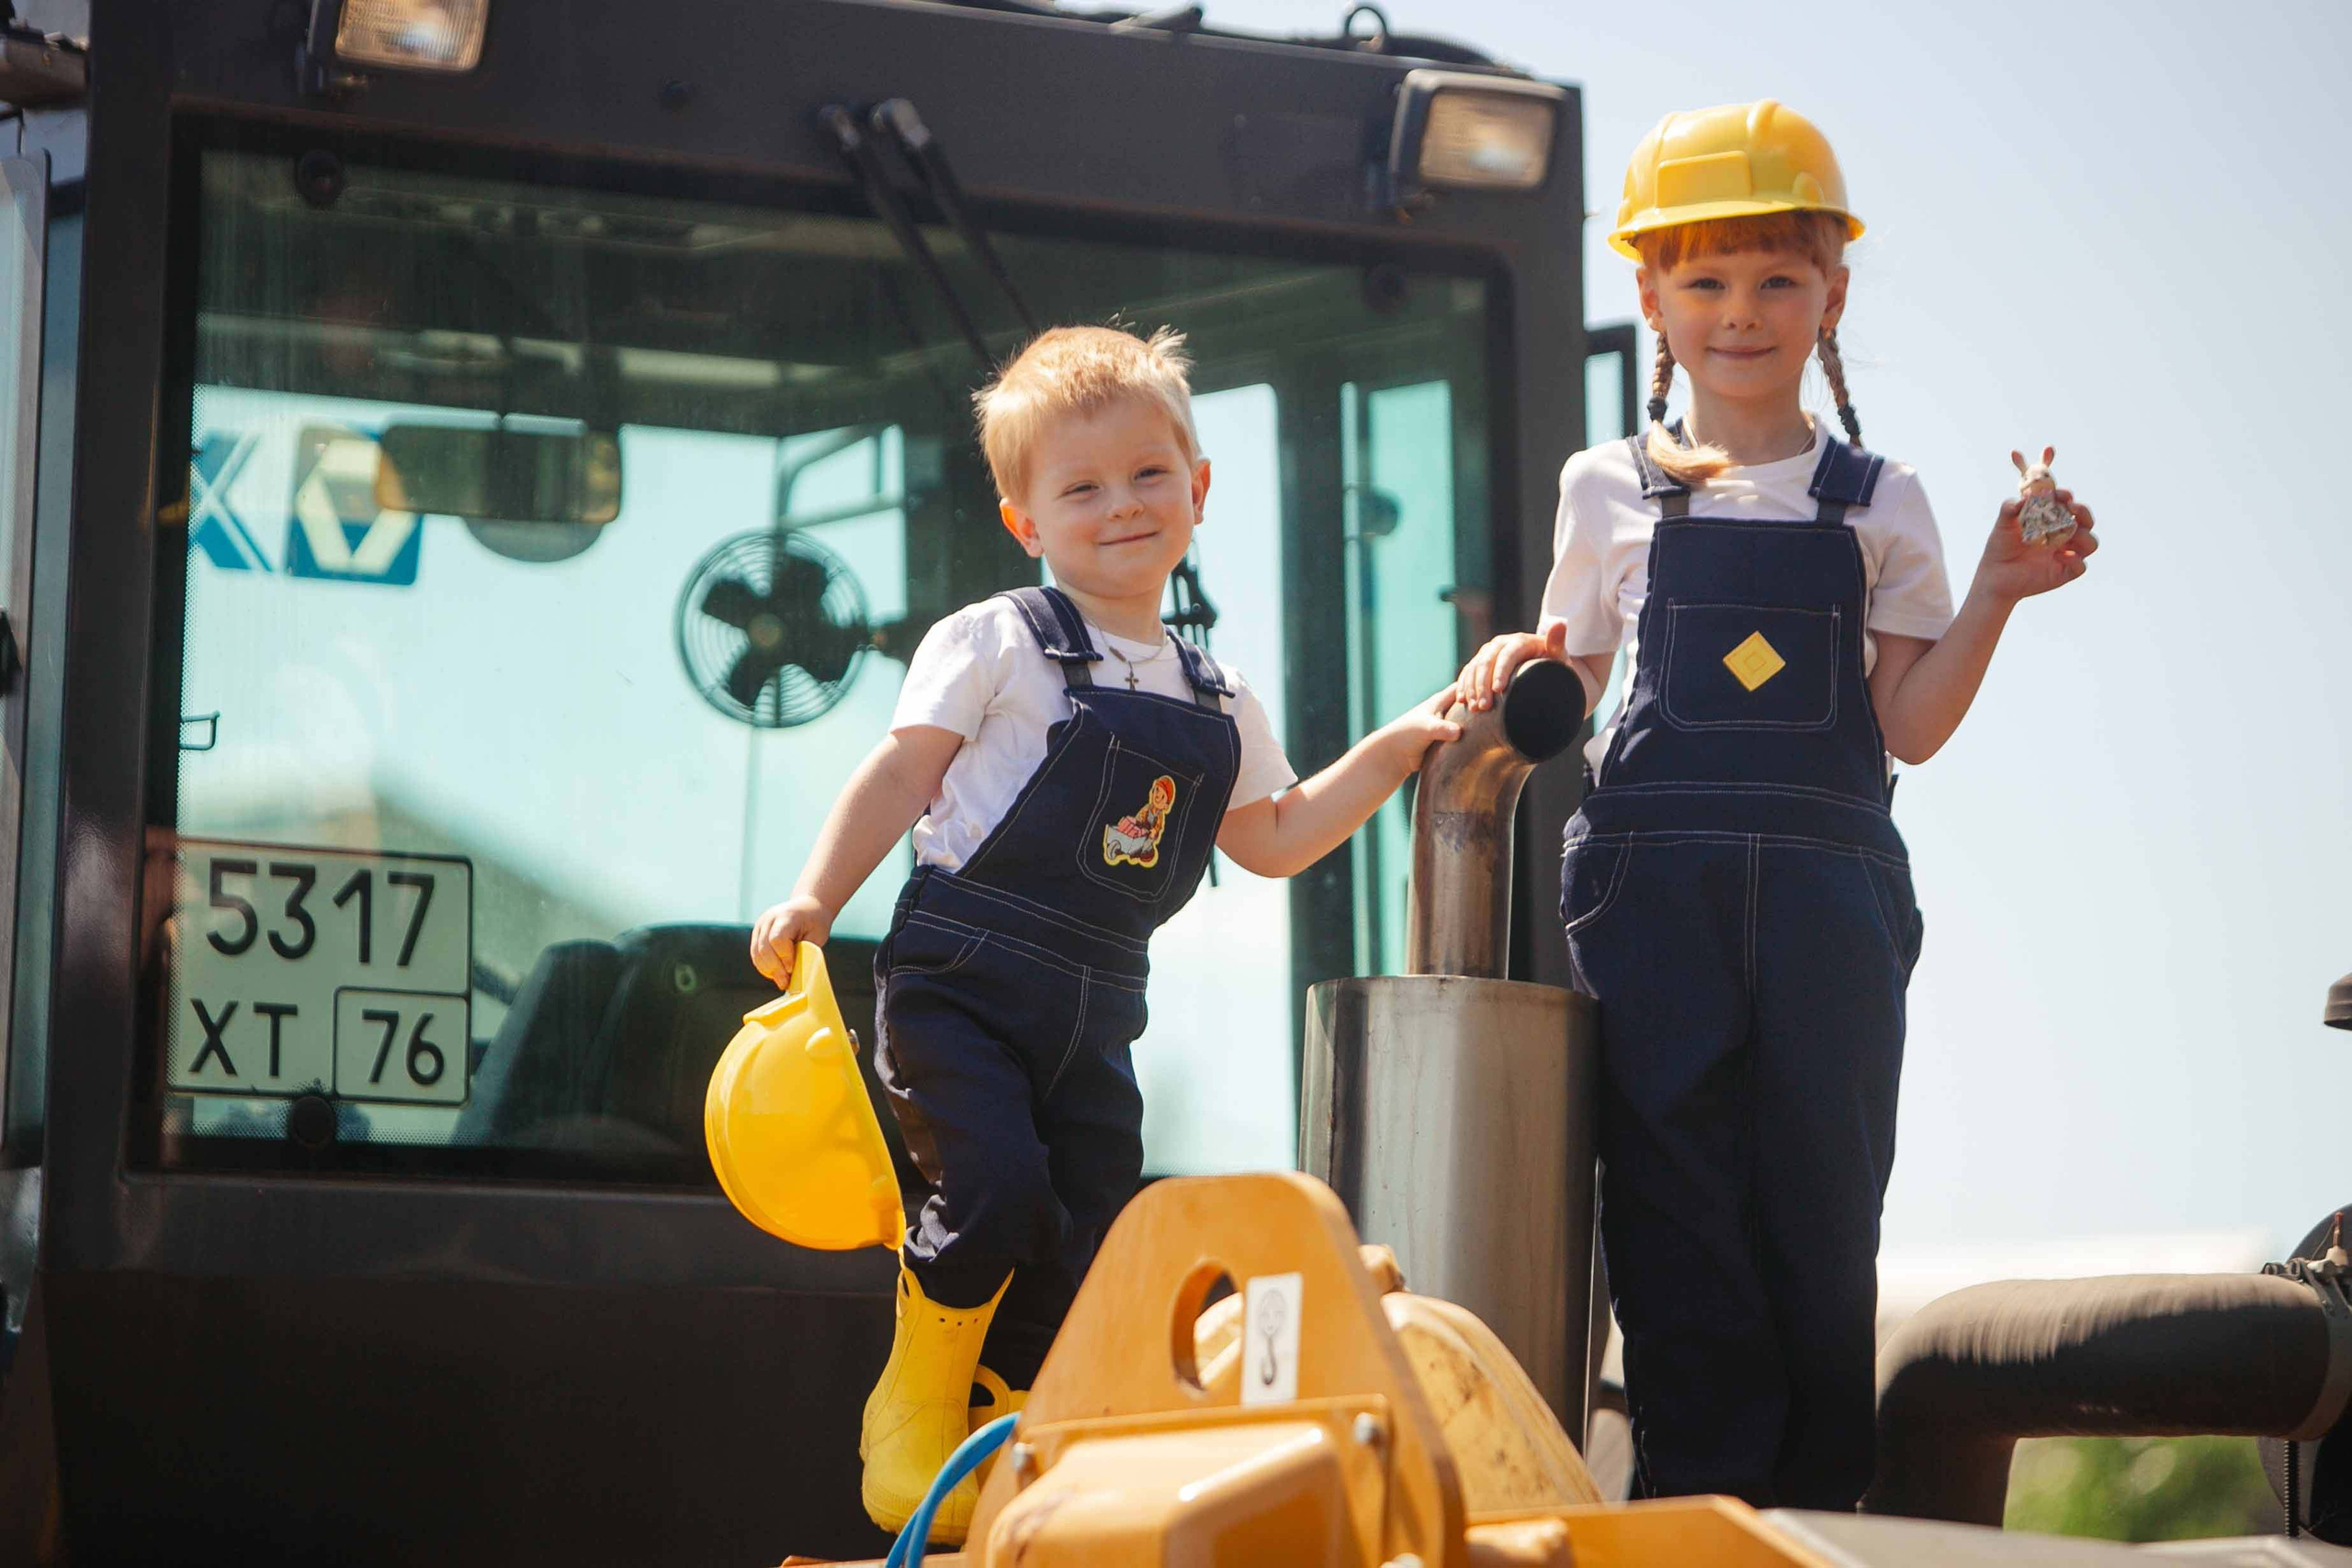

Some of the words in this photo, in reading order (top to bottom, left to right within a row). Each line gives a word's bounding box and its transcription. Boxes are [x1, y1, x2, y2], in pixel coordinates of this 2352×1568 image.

[207, 858, 435, 966] 5317
[188, 998, 299, 1077] XT
[362, 1009, 445, 1086] 76
